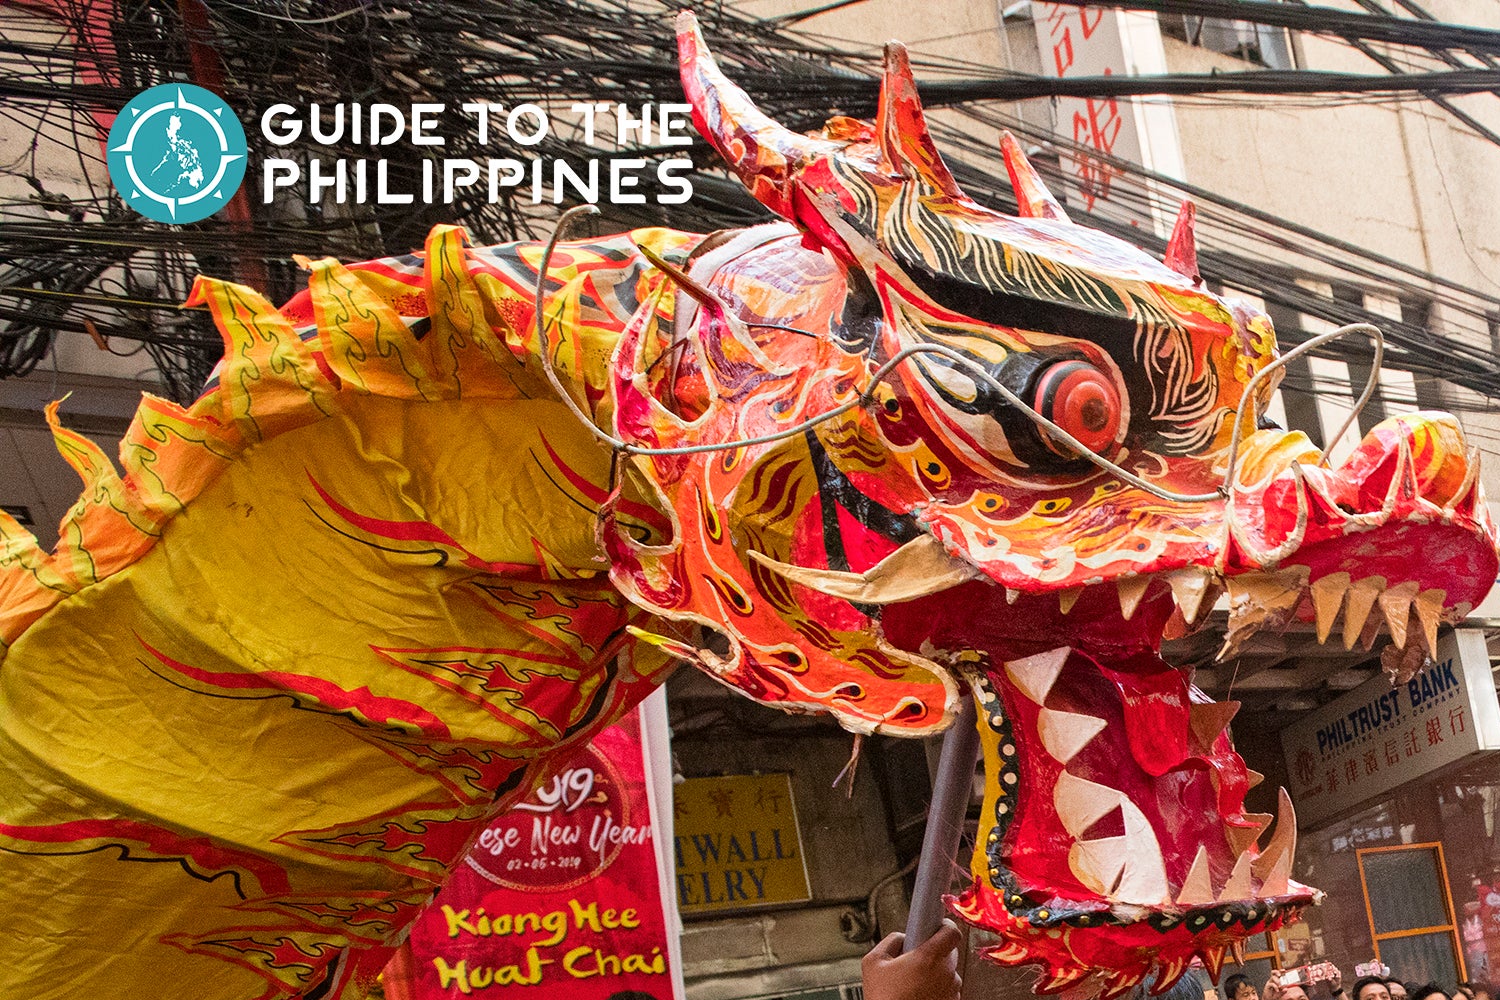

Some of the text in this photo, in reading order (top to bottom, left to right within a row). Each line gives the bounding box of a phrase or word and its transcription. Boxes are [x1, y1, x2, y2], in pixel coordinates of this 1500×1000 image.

[1316, 658, 1460, 755] PHILTRUST BANK
[1377, 714, 1408, 736] TRUST
[1412, 687, 1462, 717] COMPANY
[475, 826, 521, 856] ese
[530, 815, 581, 856] New
[568, 898, 641, 933] Hee
[432, 945, 667, 994] Huat Chai
